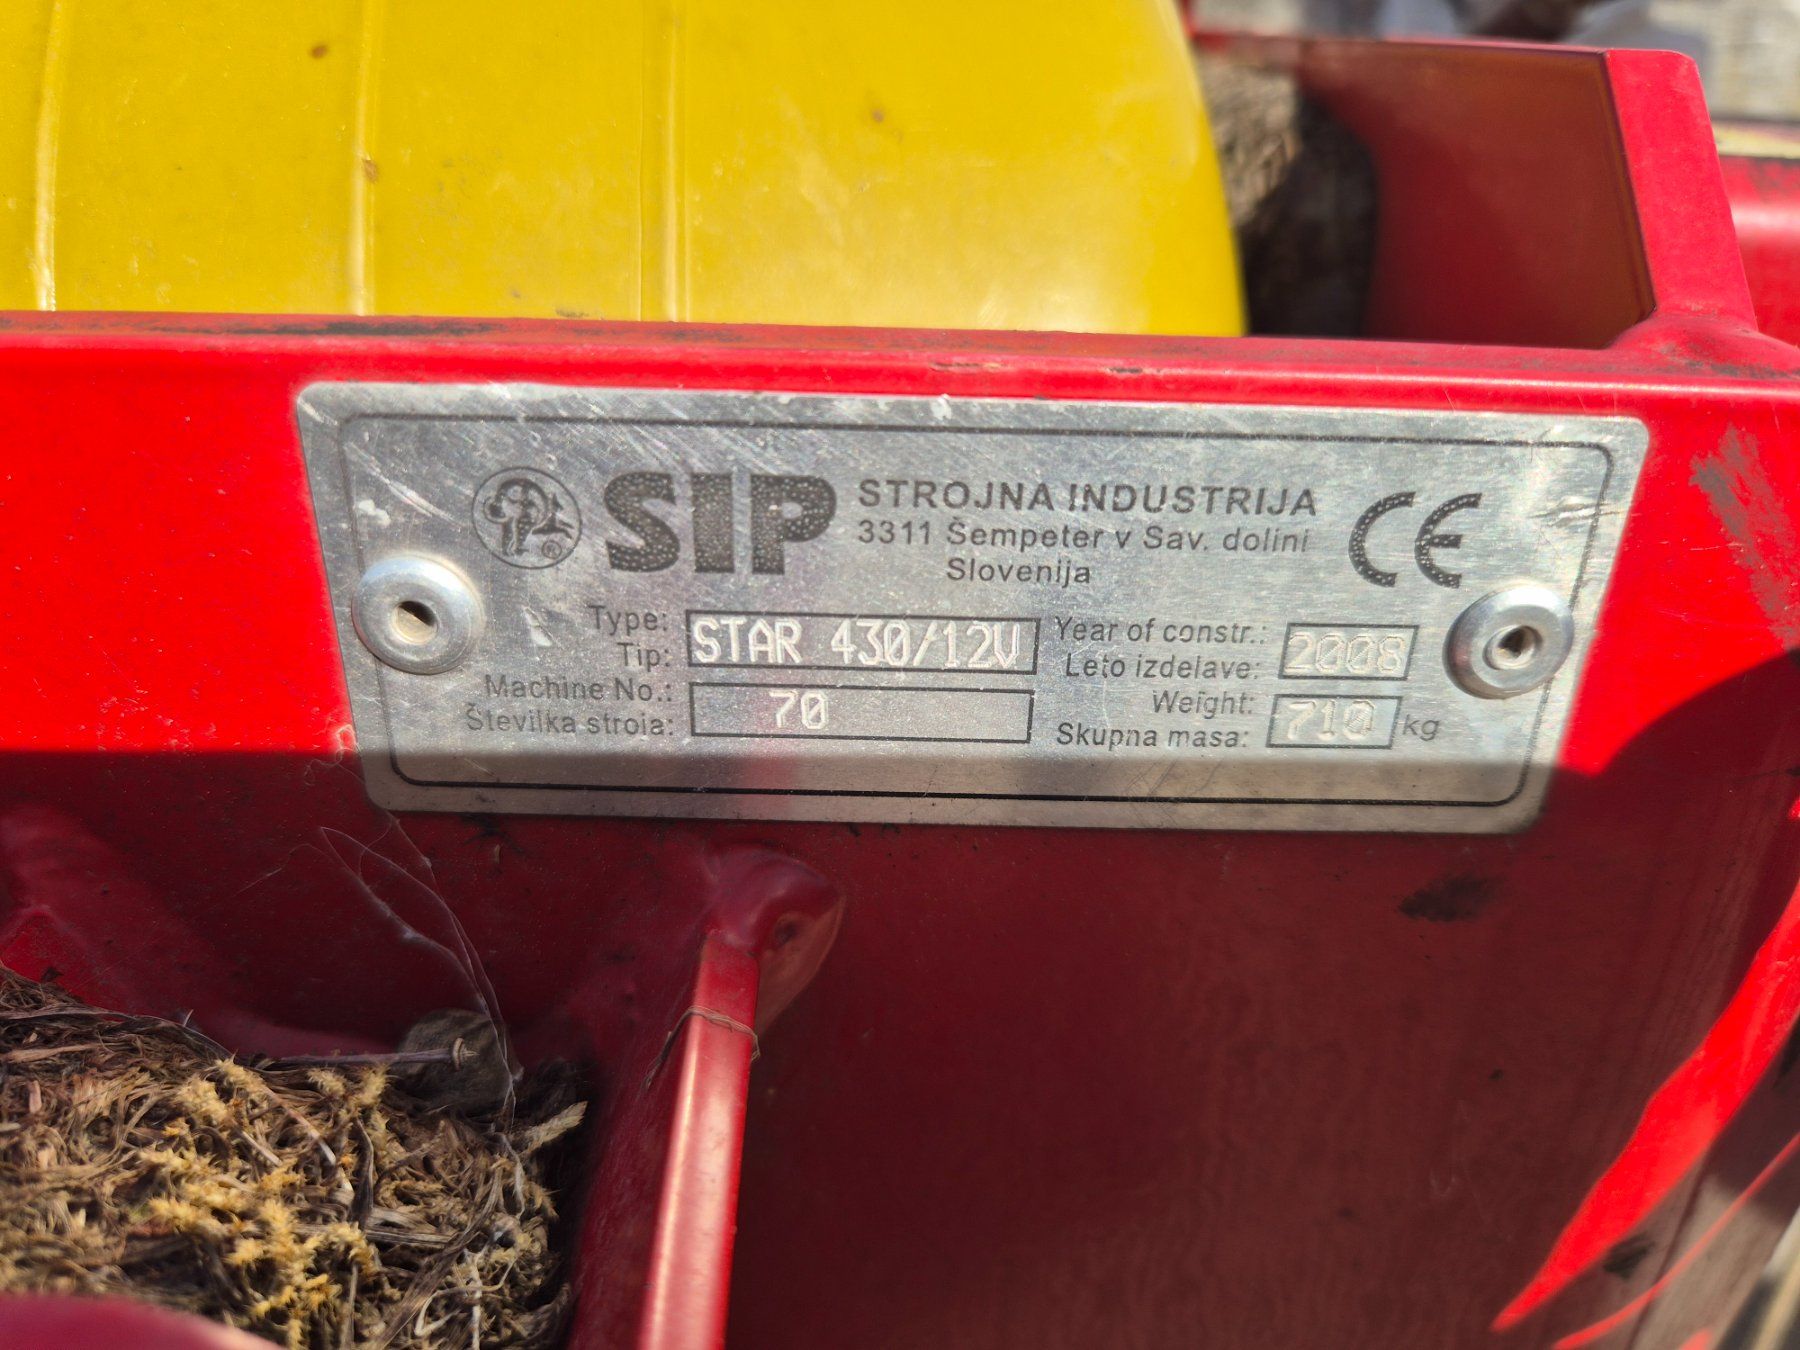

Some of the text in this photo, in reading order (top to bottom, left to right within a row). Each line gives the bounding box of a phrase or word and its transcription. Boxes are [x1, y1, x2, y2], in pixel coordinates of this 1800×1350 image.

[858, 479, 1317, 516] STROJNA INDUSTRIJA
[603, 471, 837, 575] SIP
[858, 517, 1310, 553] 3311 Šempeter v Sav. dolini
[1348, 491, 1482, 589] CE
[946, 557, 1091, 588] Slovenija
[589, 605, 667, 635] Type:
[1055, 616, 1267, 646] Year of constr.:
[617, 642, 671, 672] Tip:
[693, 616, 1020, 669] STAR 430/12V
[1283, 631, 1406, 674] 2008
[1065, 653, 1259, 680] Leto izdelave:
[485, 674, 672, 702] Machine No.:
[465, 702, 577, 734] Številka
[769, 690, 829, 731] 70
[1152, 689, 1253, 719] Weight:
[1288, 699, 1376, 741] 710
[1402, 714, 1440, 740] kg
[1056, 722, 1248, 751] Skupna masa:
